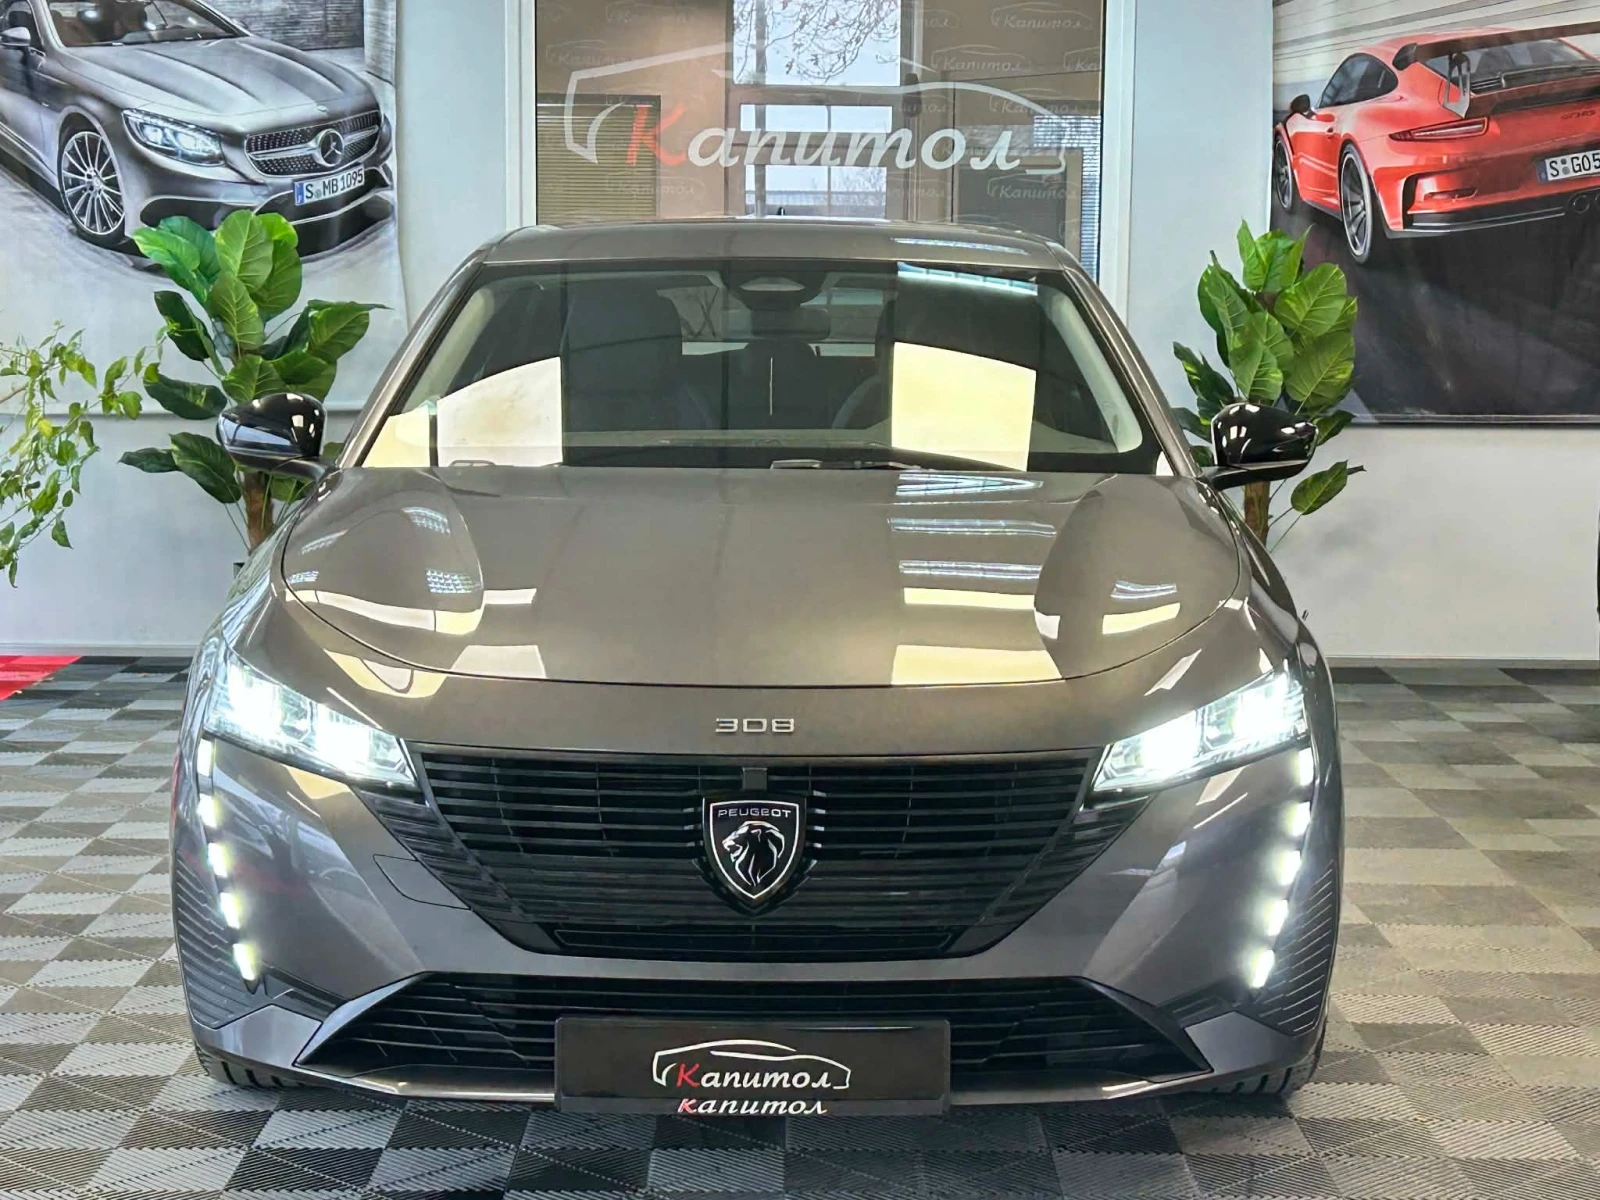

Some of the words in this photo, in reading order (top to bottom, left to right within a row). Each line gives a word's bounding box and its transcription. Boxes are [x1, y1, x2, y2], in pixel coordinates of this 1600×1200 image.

[626, 103, 1020, 170] Капитол
[1549, 160, 1559, 177] S
[305, 183, 313, 199] S
[716, 718, 795, 733] 308
[717, 807, 792, 819] PEUGEOT
[676, 1063, 832, 1088] Капитол
